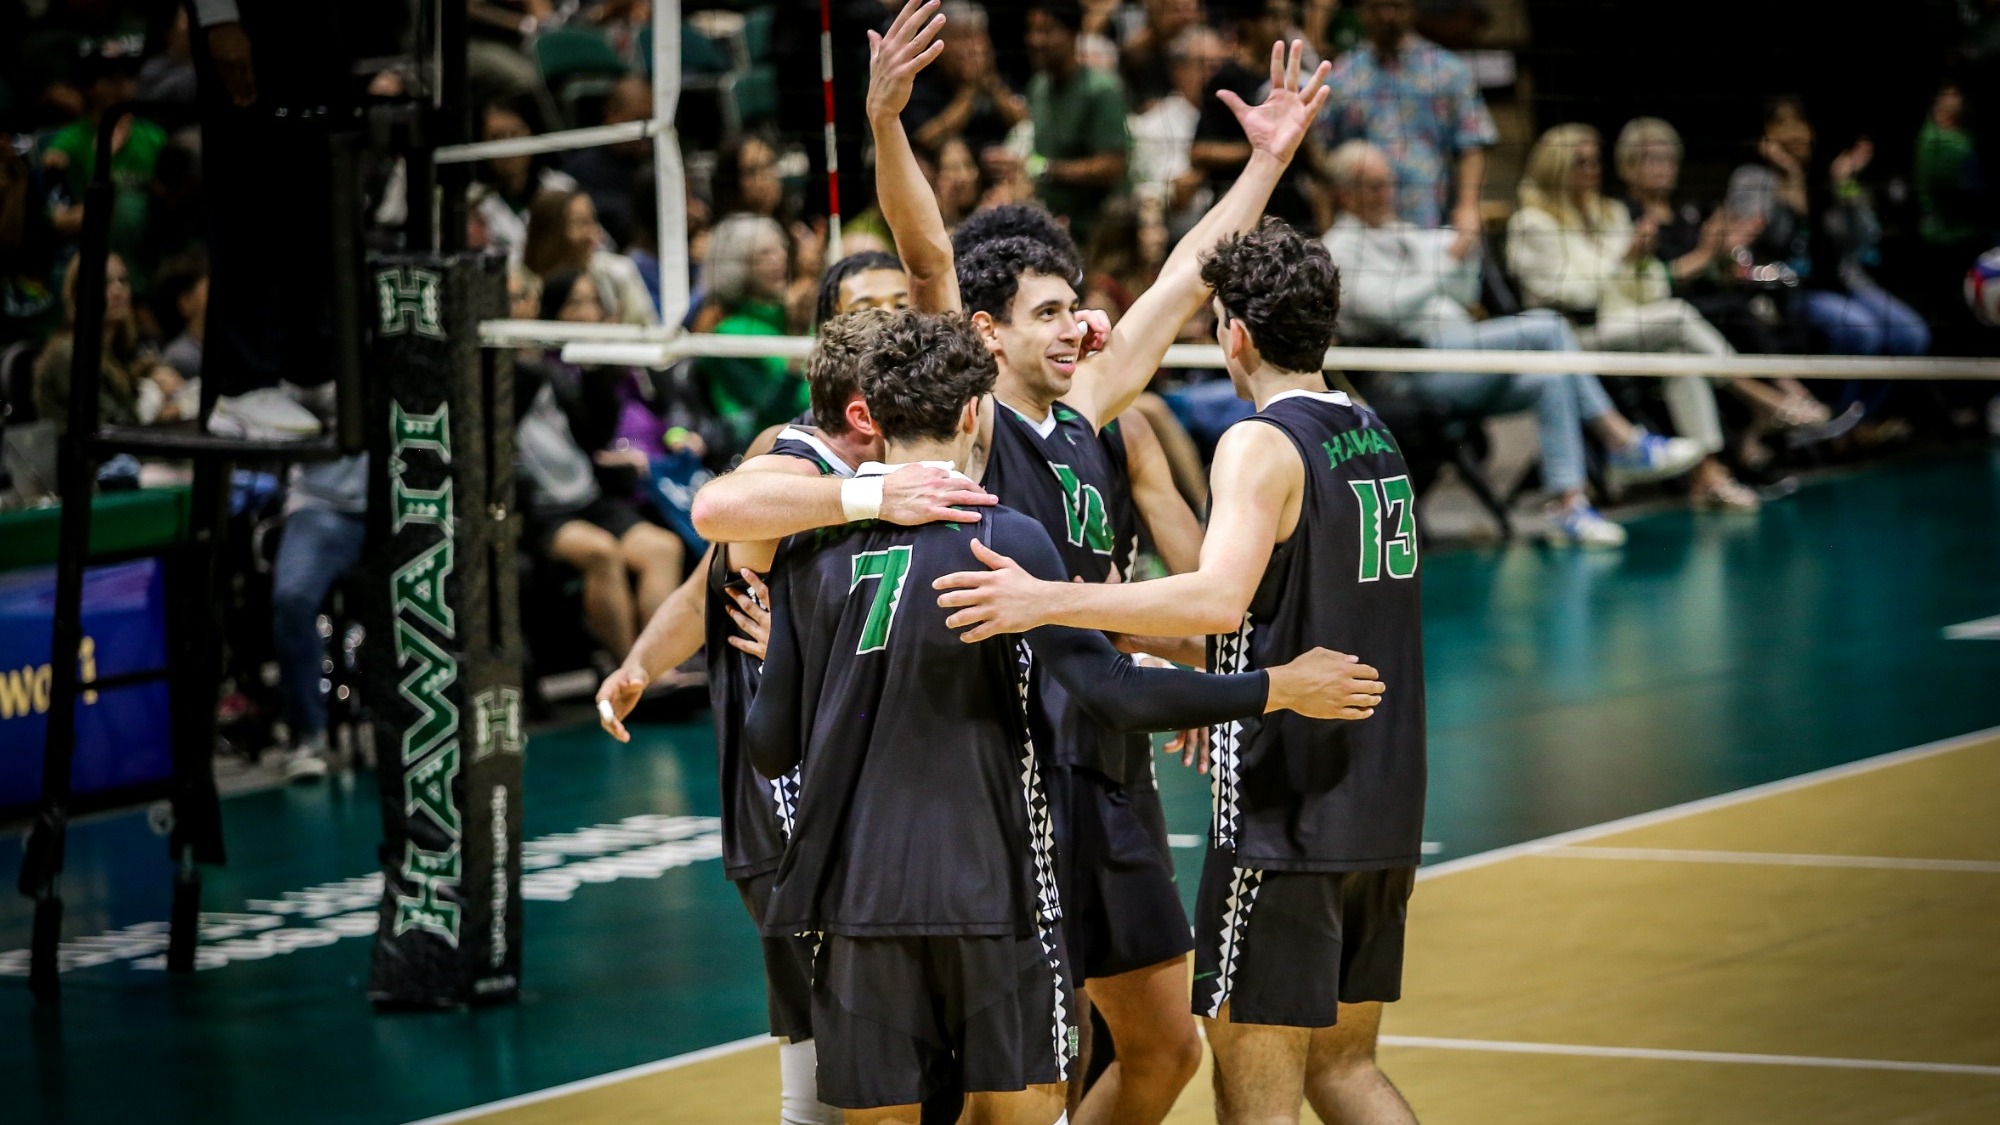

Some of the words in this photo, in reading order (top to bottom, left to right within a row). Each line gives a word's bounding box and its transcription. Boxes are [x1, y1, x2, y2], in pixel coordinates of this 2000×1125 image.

[376, 266, 446, 340] H
[1347, 474, 1418, 583] 13
[848, 544, 914, 655] 7
